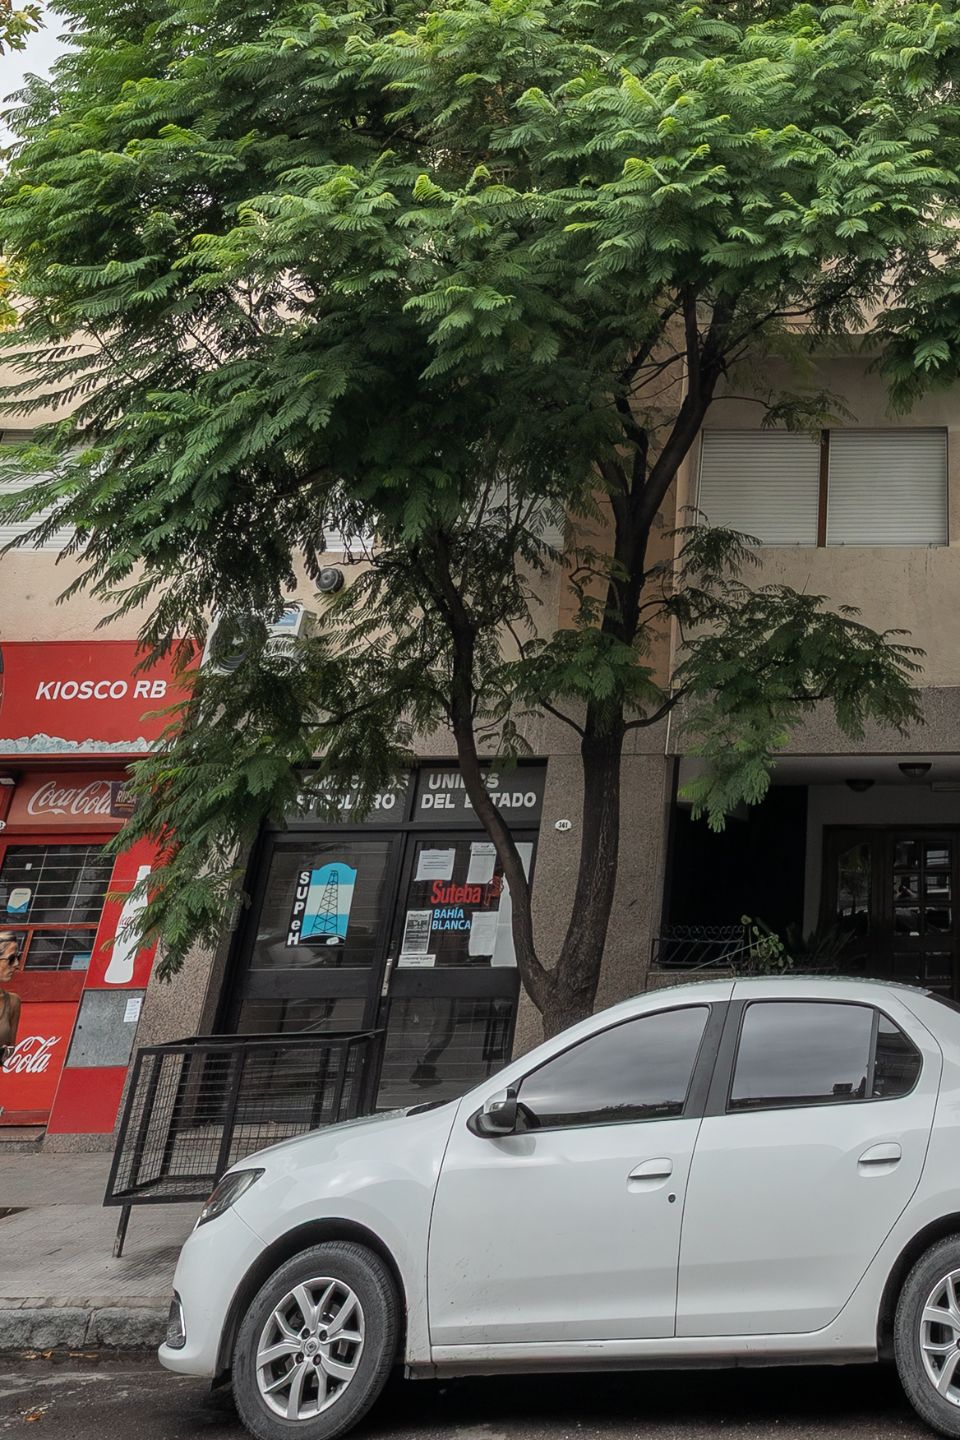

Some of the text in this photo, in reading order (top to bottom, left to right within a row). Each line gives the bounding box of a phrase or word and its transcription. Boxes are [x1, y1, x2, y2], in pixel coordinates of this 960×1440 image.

[35, 680, 167, 700] KIOSCO RB
[420, 794, 456, 809] DEL
[463, 791, 537, 809] ETADO
[431, 879, 482, 904] Suteba
[433, 906, 465, 919] BAHÍA
[431, 920, 472, 931] BLANCA
